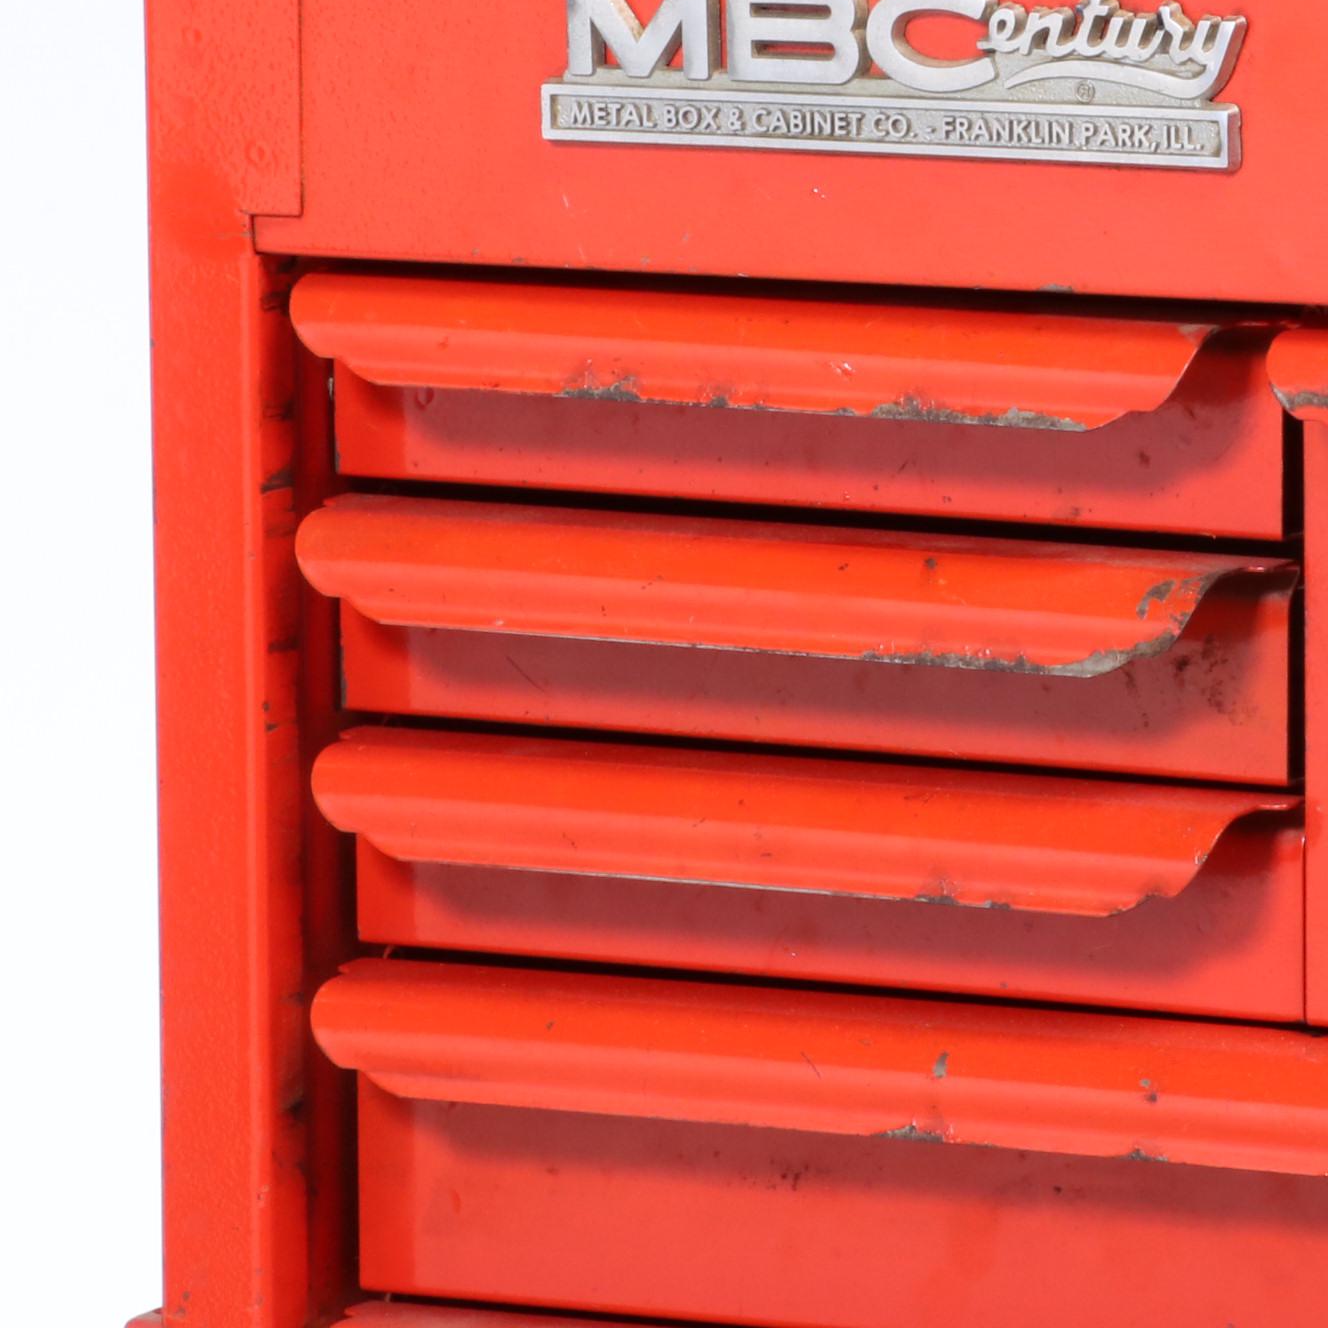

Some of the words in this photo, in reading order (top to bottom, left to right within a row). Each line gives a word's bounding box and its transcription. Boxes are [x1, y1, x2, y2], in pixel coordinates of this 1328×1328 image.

[570, 100, 654, 129] METAL
[662, 104, 720, 131] BOX
[727, 106, 745, 132] &
[751, 108, 863, 136] CABINET
[871, 112, 917, 138] CO.
[942, 116, 1071, 145] FRANKLIN
[1082, 121, 1159, 153] PARK,
[1162, 125, 1205, 151] ILL.
